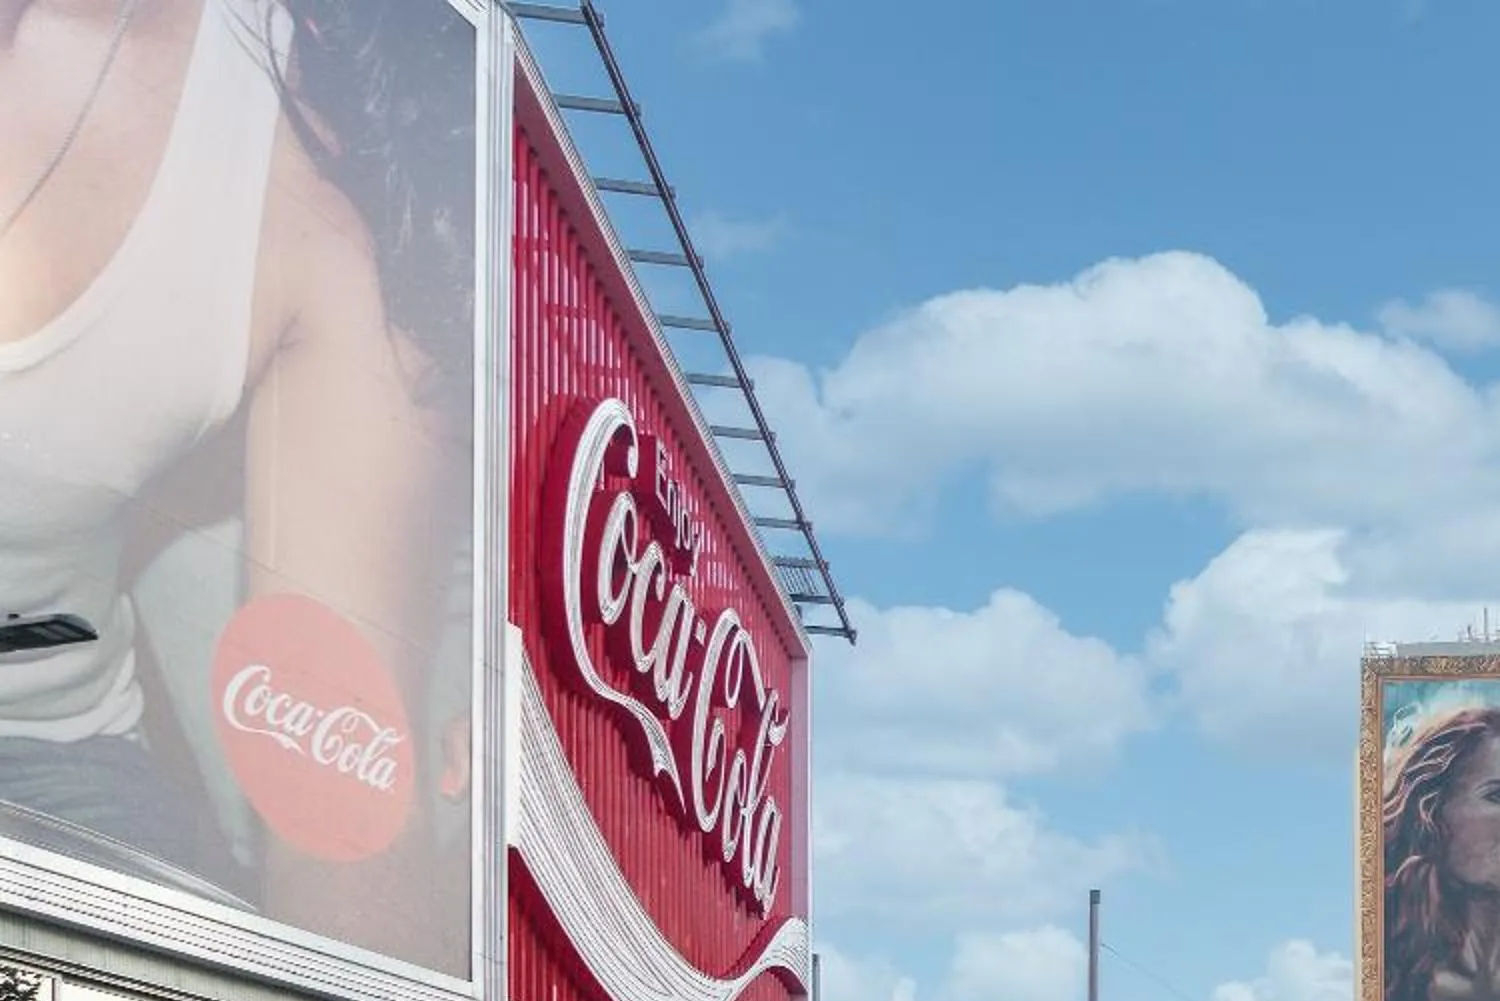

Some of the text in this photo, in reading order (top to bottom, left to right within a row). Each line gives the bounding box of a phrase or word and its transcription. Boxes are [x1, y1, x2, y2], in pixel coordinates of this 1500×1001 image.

[656, 439, 702, 577] Enjoy
[562, 397, 790, 914] Coca-Cola
[223, 664, 406, 792] Coca-Cola
